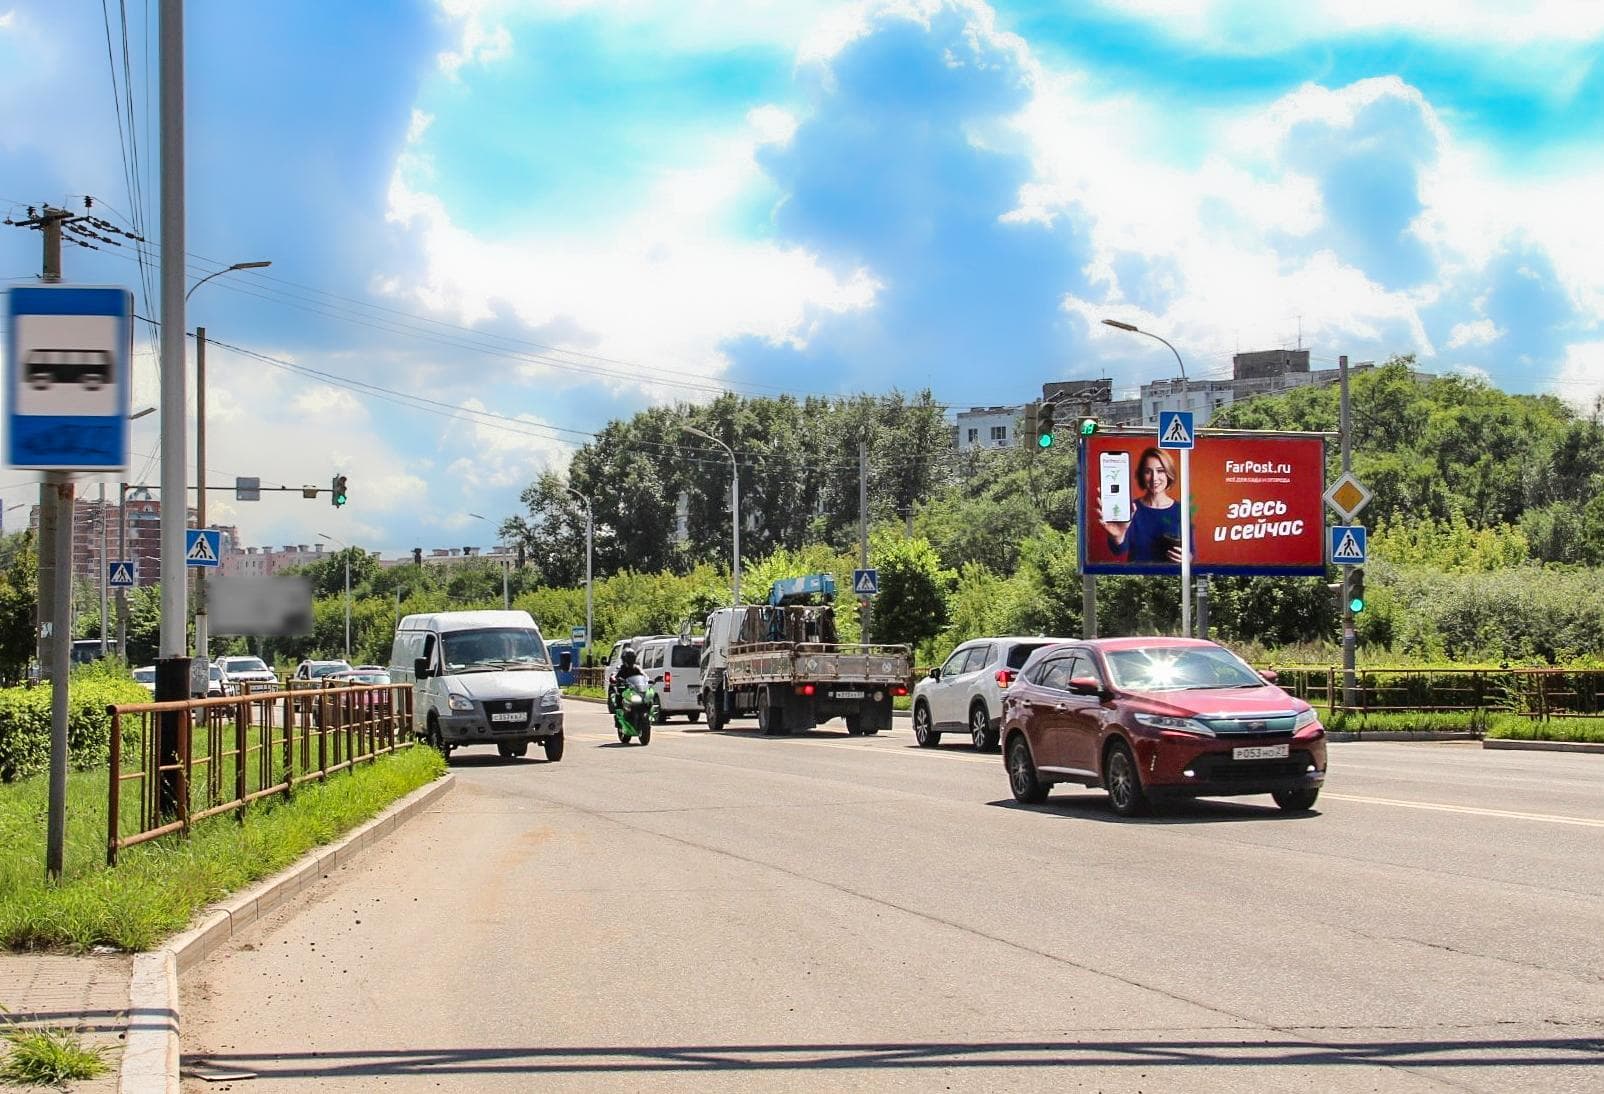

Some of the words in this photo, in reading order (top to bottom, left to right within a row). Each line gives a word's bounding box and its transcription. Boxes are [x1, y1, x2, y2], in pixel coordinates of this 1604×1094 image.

[1225, 460, 1291, 474] FarPost.ru
[1226, 498, 1287, 519] здесь
[1214, 526, 1227, 542] и
[1230, 518, 1304, 541] сейчас
